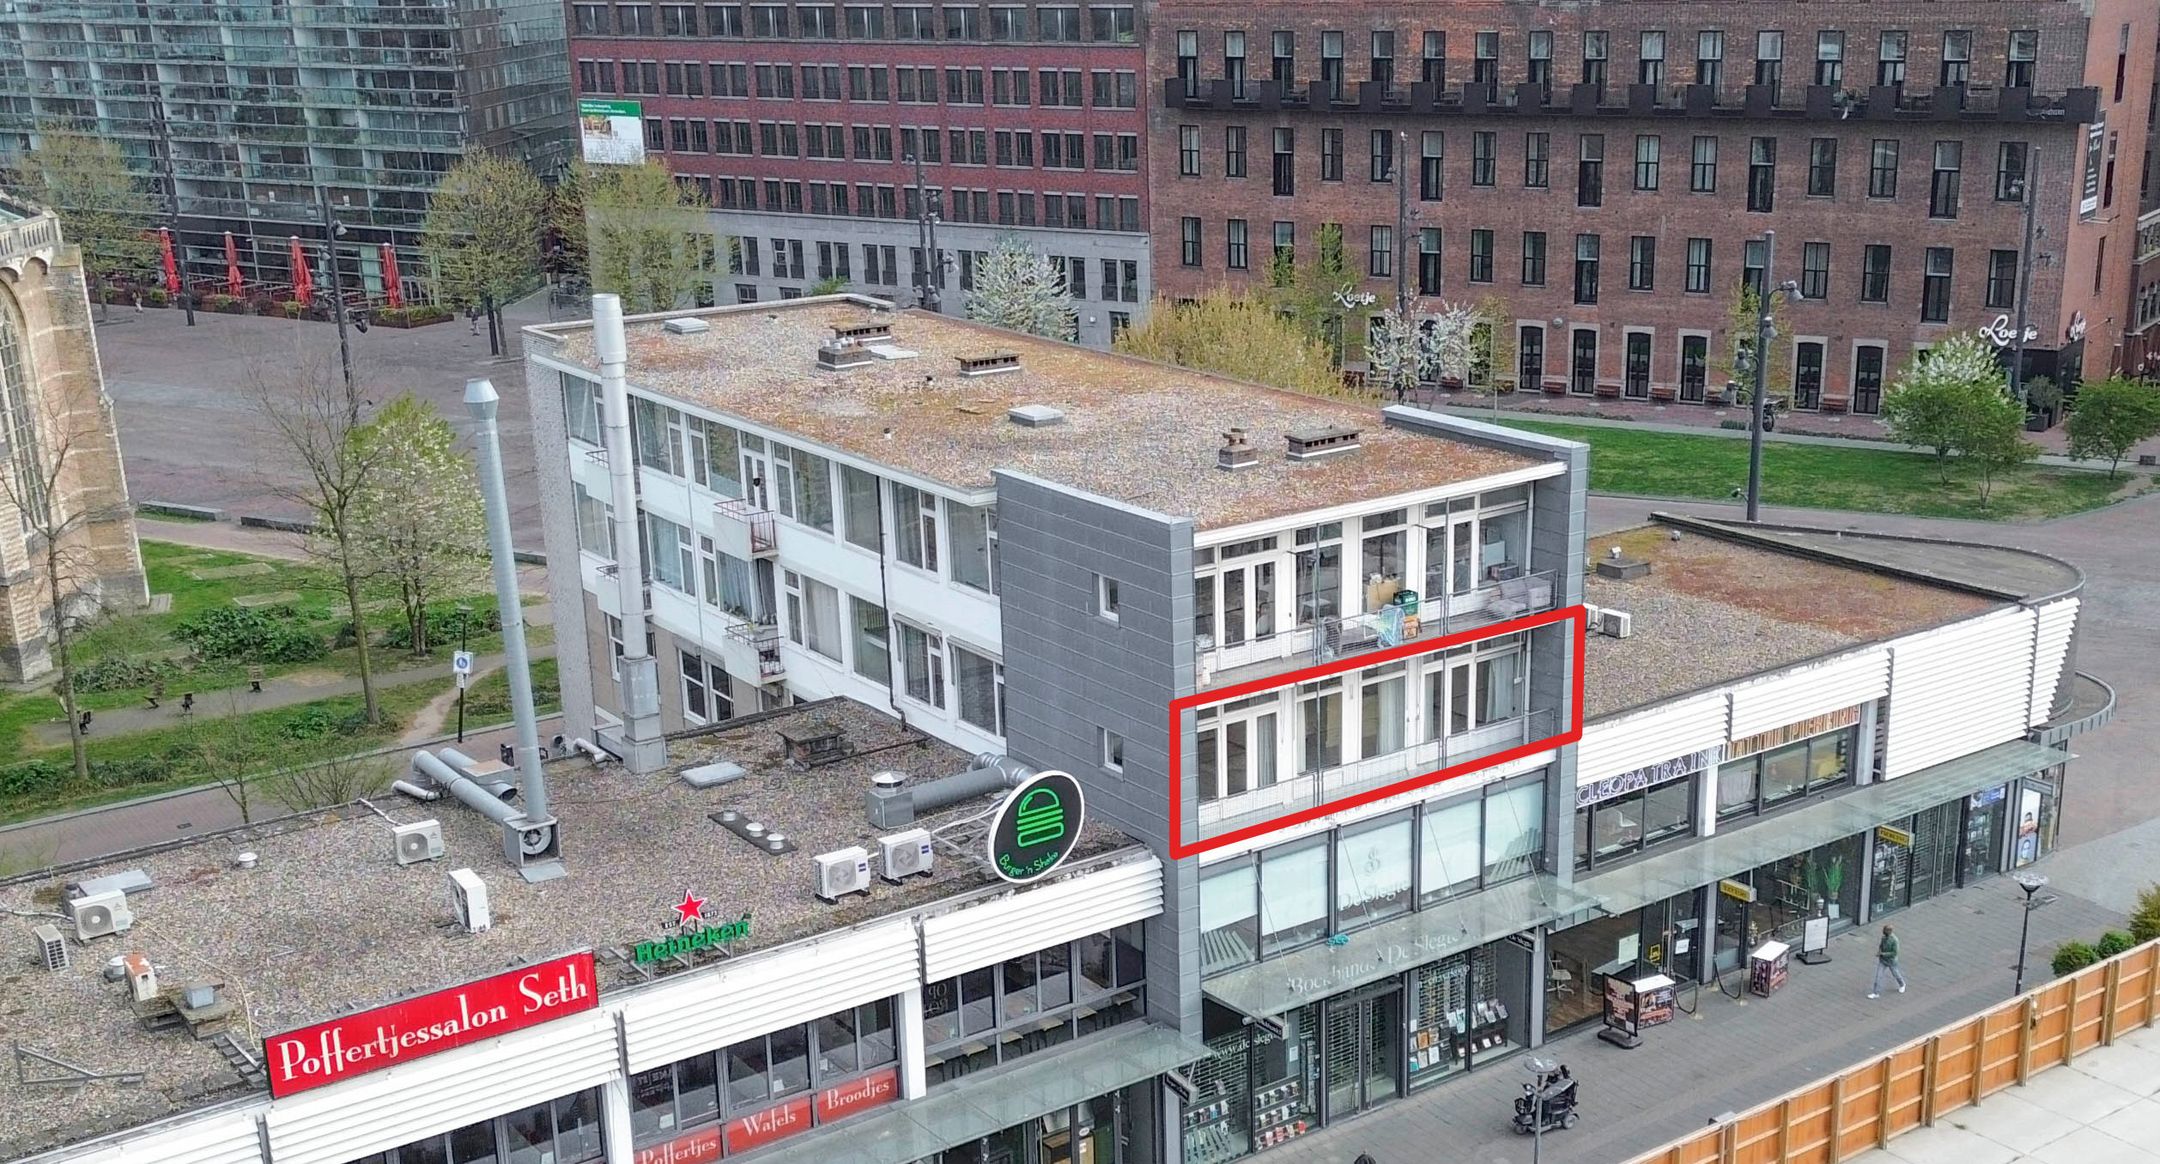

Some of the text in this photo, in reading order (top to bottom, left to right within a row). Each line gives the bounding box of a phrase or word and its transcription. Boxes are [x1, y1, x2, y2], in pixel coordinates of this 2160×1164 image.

[1979, 314, 2038, 346] Loeje
[1691, 745, 1725, 774] INK
[1000, 853, 1024, 877] Burger
[1034, 851, 1059, 871] Shake
[635, 921, 750, 964] Heineken
[277, 963, 588, 1082] Poffertjessalon Seth
[826, 1077, 890, 1111] Broodjes
[742, 1104, 797, 1137] Wafels
[641, 1137, 718, 1164] Poffertjes
